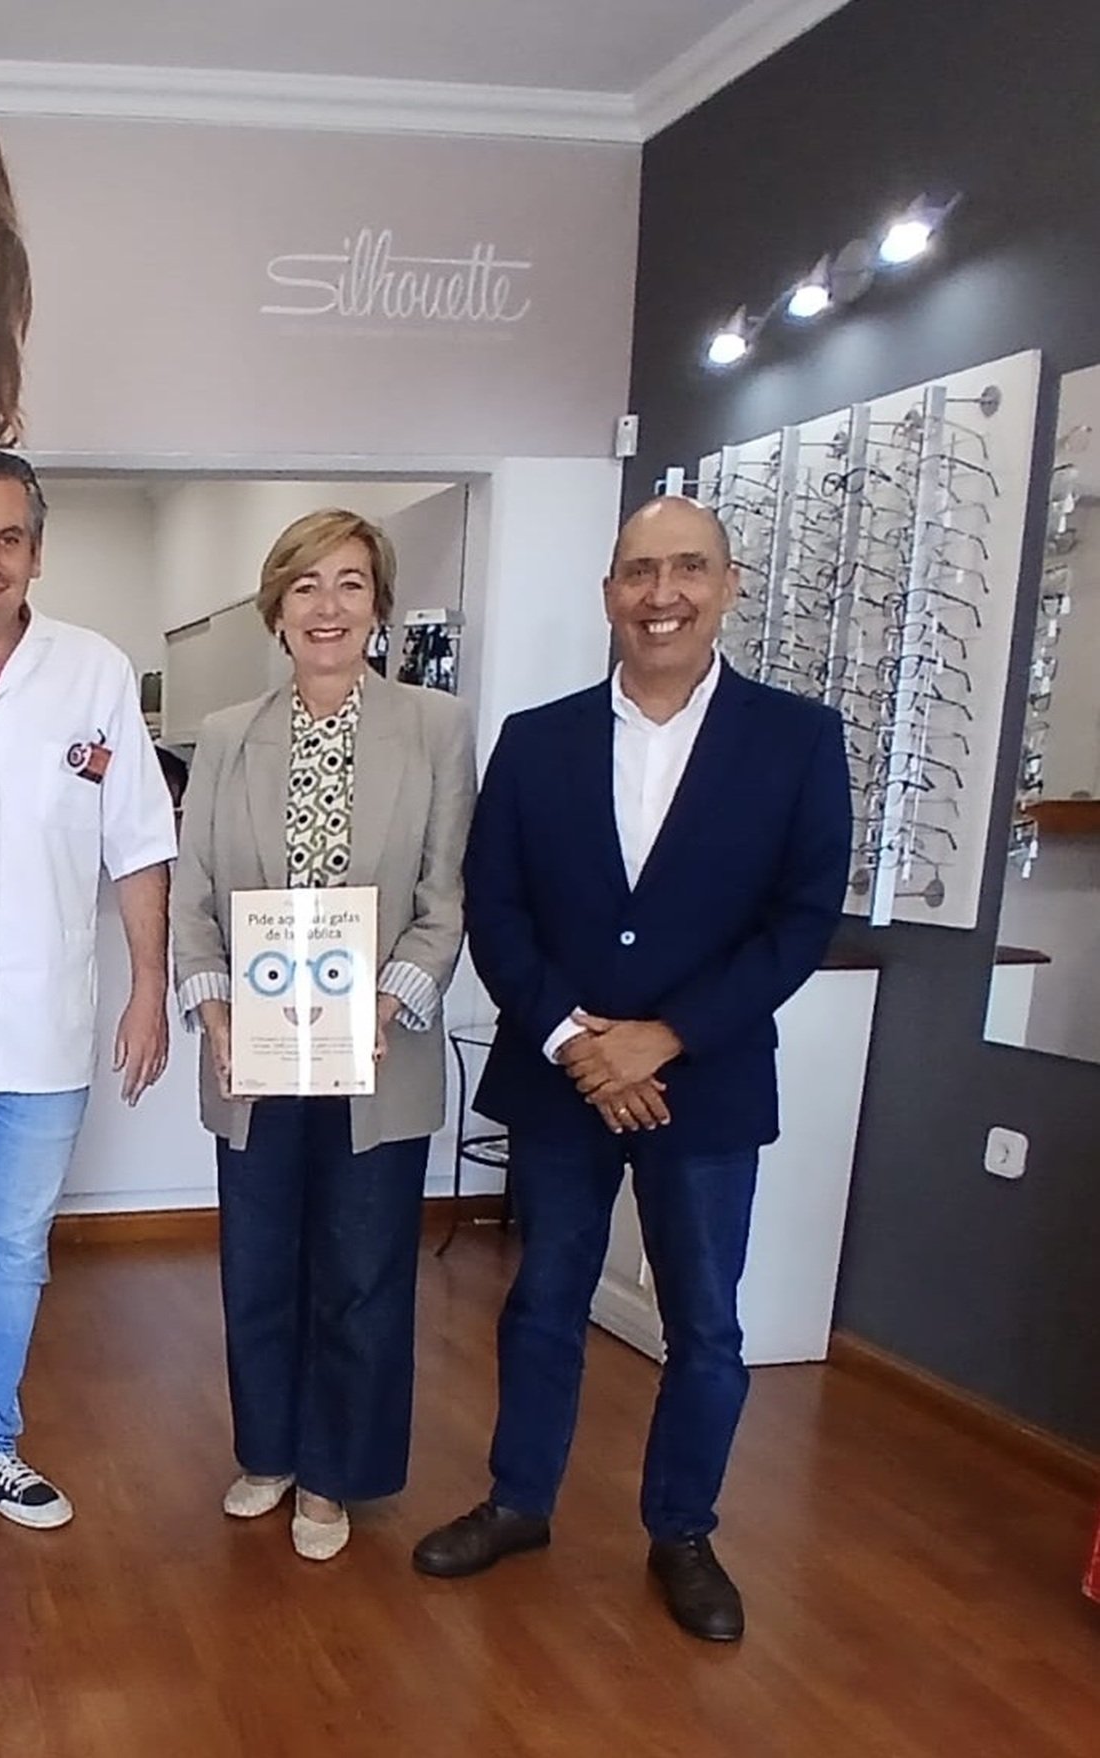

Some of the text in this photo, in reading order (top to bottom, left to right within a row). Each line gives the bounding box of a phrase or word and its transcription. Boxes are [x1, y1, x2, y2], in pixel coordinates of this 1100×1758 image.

[260, 228, 532, 321] Silhouette
[247, 913, 274, 926] Pide
[330, 910, 361, 927] gafas
[265, 928, 281, 941] de
